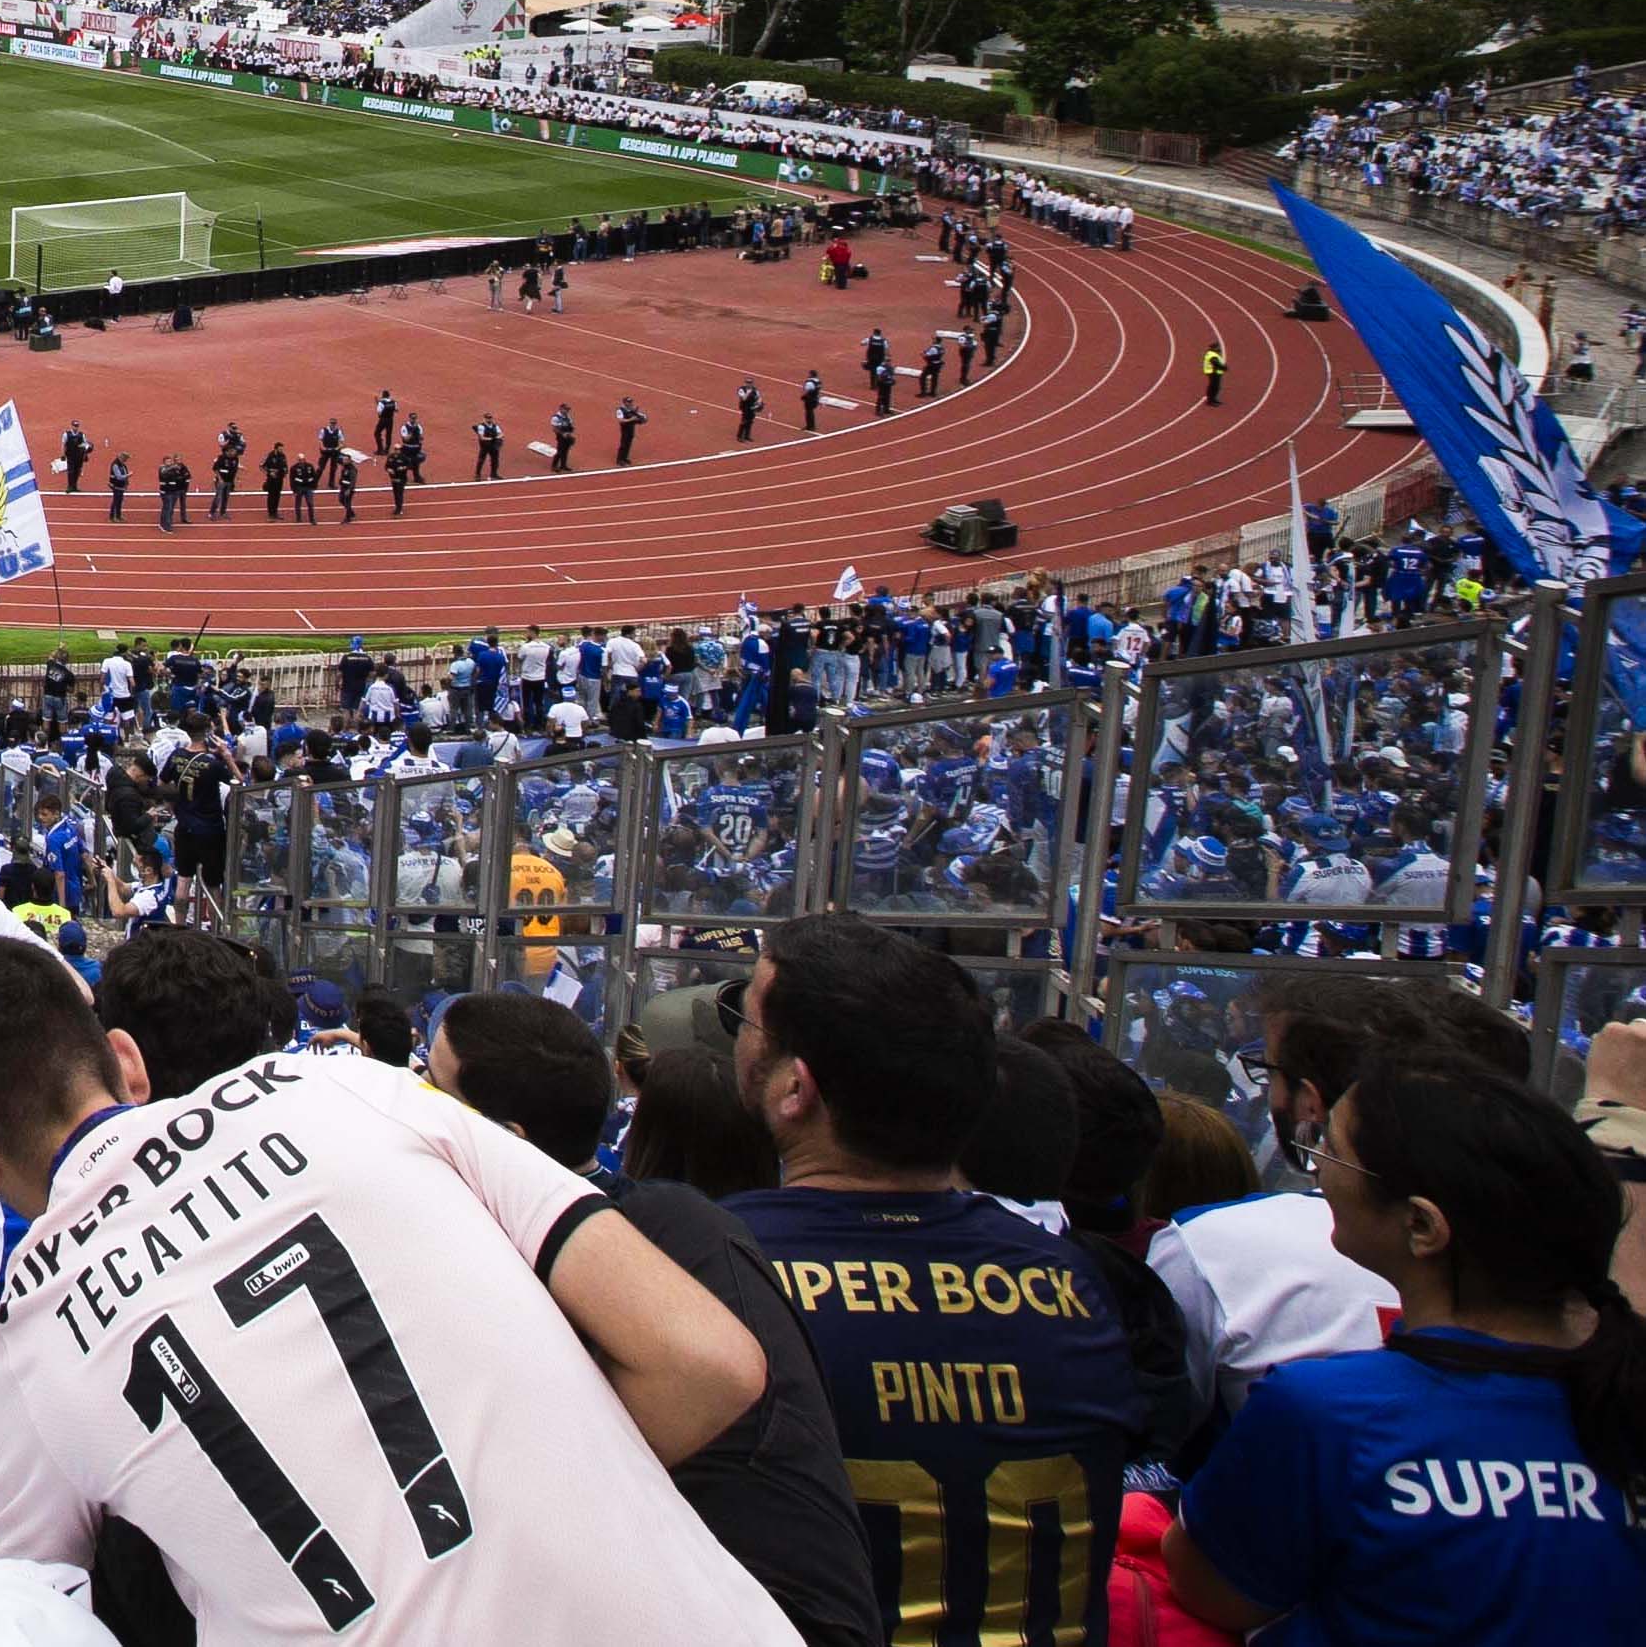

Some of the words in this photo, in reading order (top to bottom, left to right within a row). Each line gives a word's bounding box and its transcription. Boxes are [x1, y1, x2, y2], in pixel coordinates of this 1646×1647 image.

[719, 814, 752, 845] 20
[1312, 866, 1343, 880] SUPER
[89, 1135, 119, 1162] Porto
[132, 1060, 303, 1188] BOCK
[56, 1132, 308, 1355] TECATITO
[273, 1248, 305, 1276] bwin
[928, 1262, 1091, 1318] BOCK
[156, 1340, 181, 1374] bwin
[871, 1360, 1026, 1425] PINTO
[122, 1212, 474, 1633] 17
[1384, 1458, 1606, 1522] SUPER
